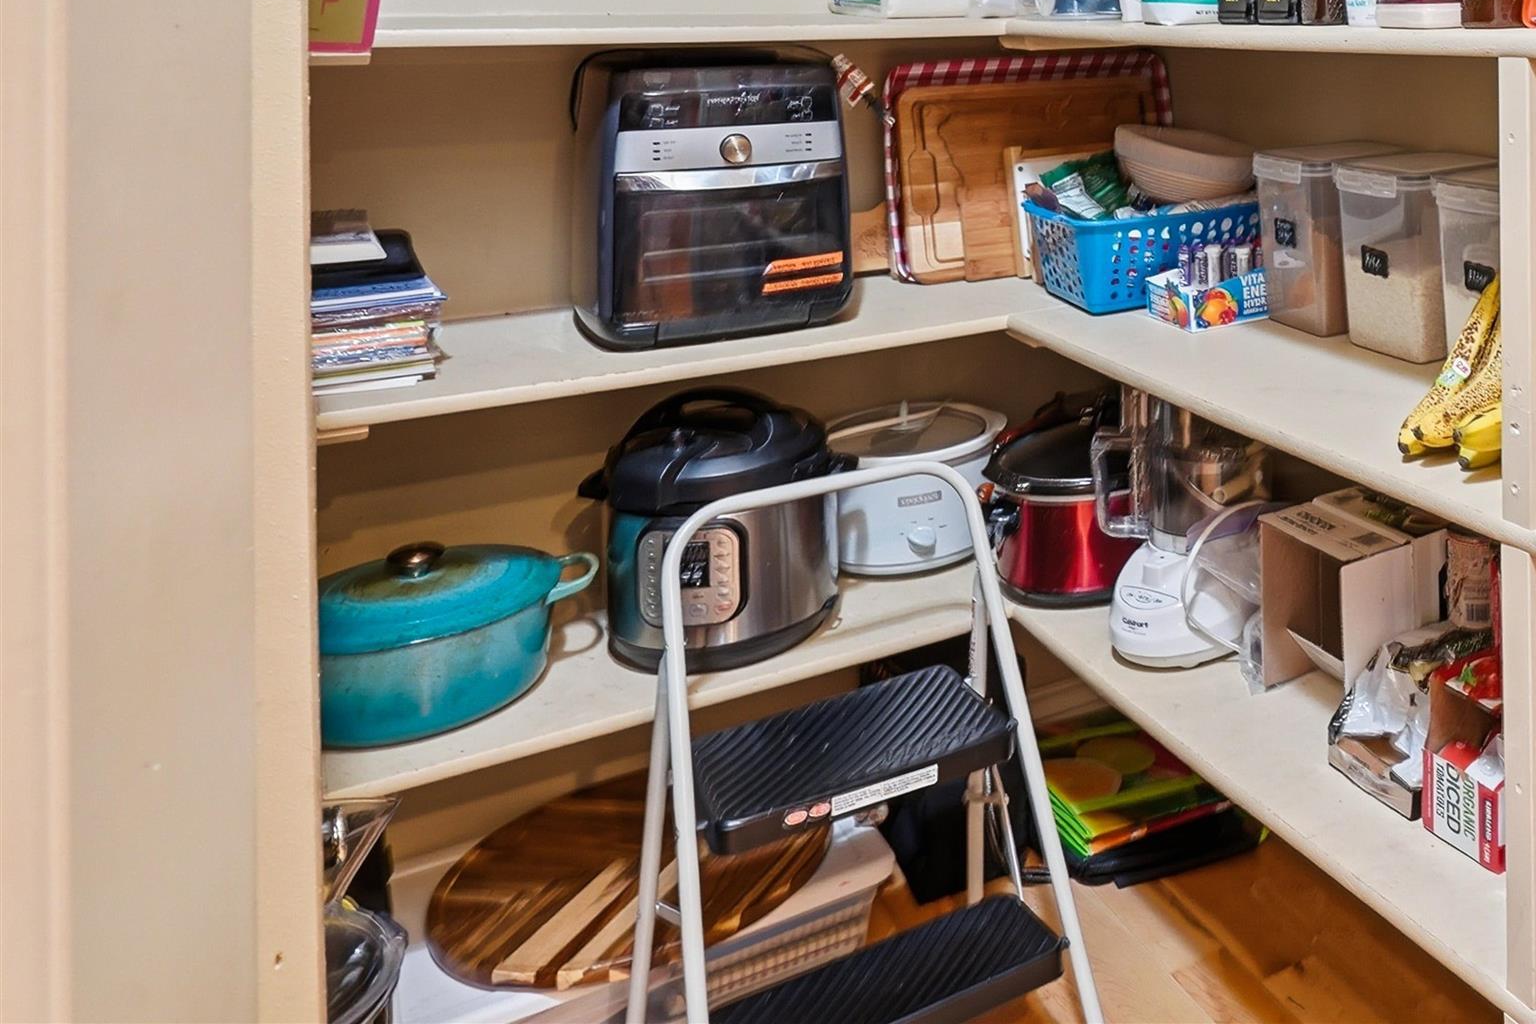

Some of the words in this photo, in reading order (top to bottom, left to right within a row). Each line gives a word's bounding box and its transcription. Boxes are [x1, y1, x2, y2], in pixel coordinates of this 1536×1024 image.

[1239, 272, 1266, 286] VITA
[1242, 284, 1267, 298] ENE
[1436, 762, 1445, 819] TOMATOES
[1446, 762, 1461, 835] DICED
[1463, 778, 1476, 842] ORGANIC
